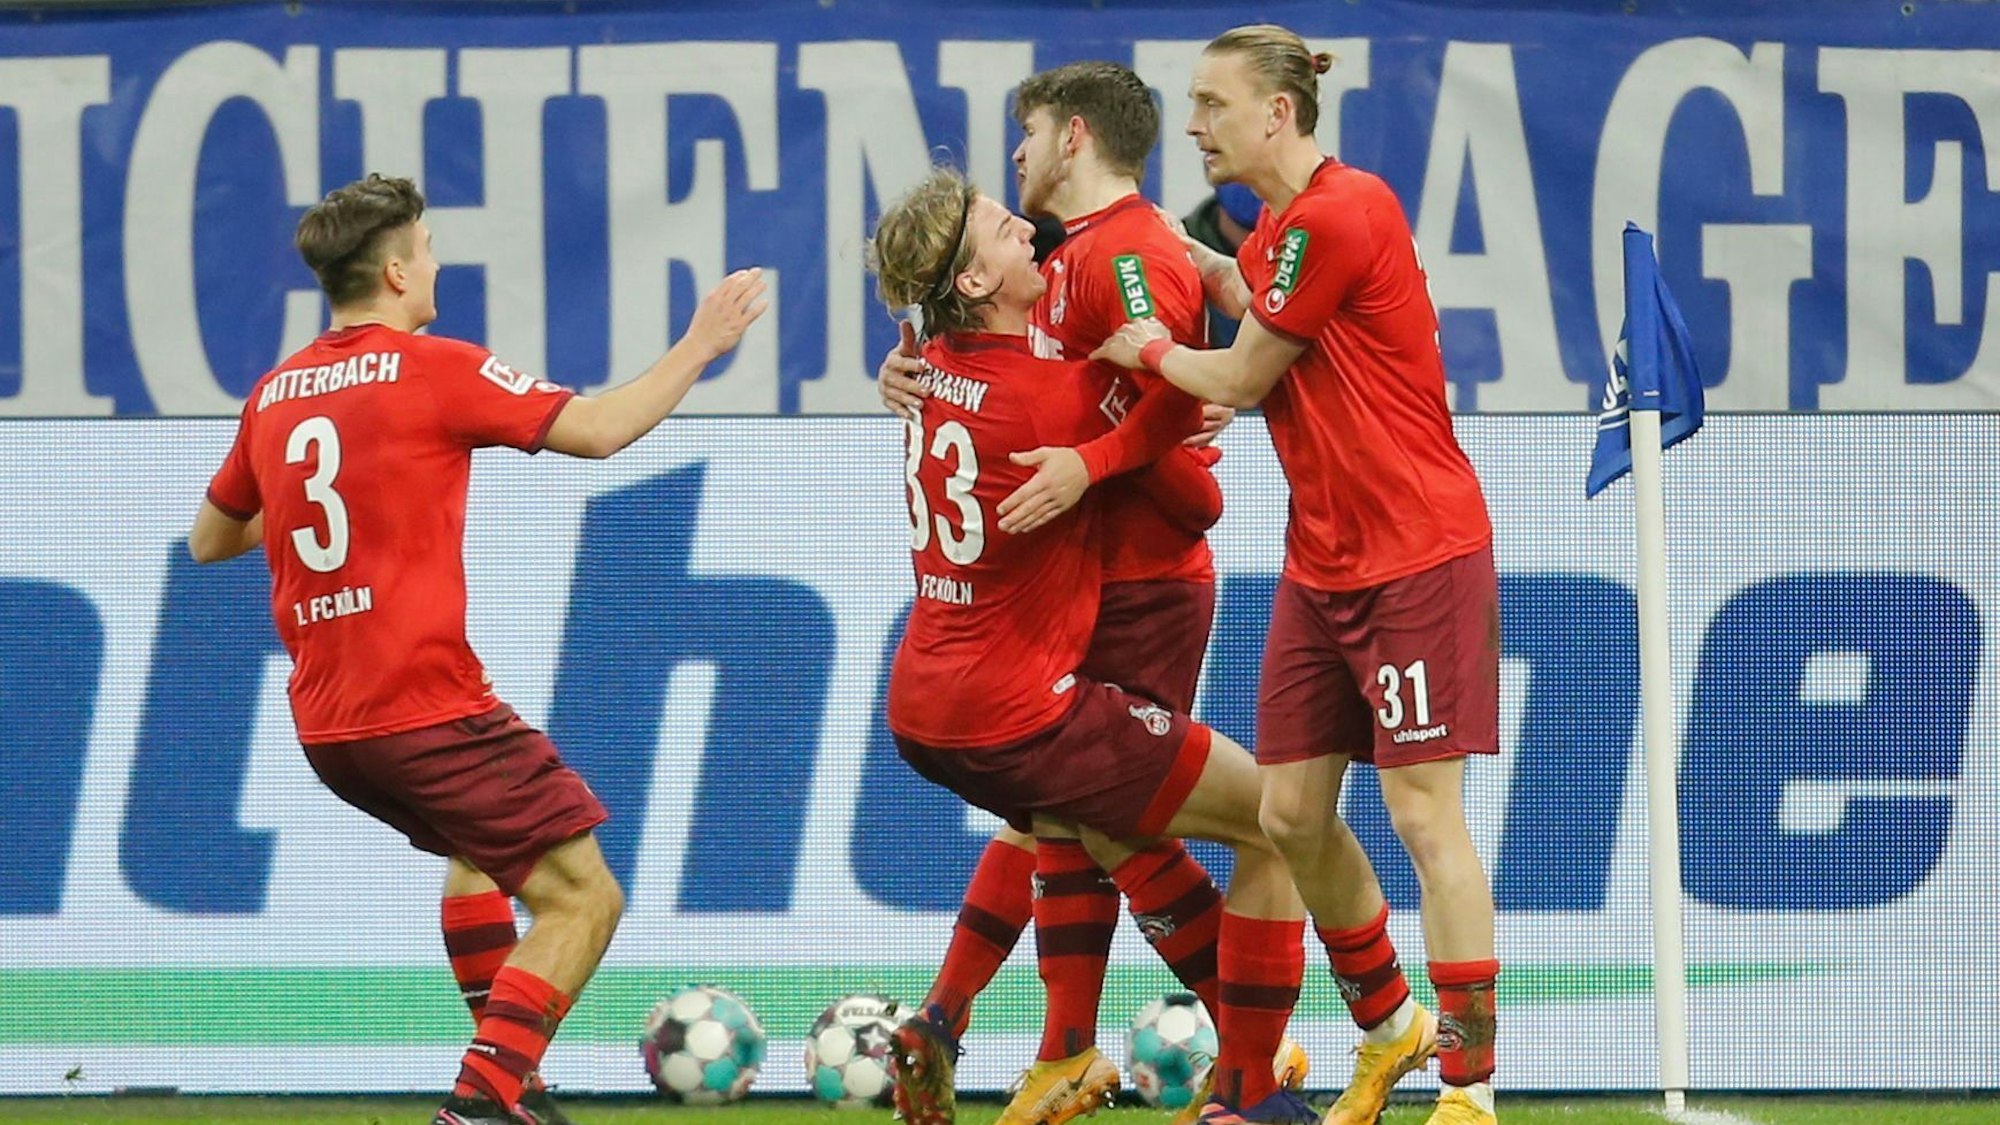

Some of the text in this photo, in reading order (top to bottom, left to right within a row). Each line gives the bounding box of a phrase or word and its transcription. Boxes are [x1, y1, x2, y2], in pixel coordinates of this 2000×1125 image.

[1118, 258, 1149, 314] DEVK
[1274, 236, 1302, 287] DEVK
[285, 416, 349, 572] 3
[902, 406, 984, 565] 33
[310, 594, 335, 622] FC
[1377, 659, 1429, 728] 31
[1393, 724, 1447, 743] uhlsport
